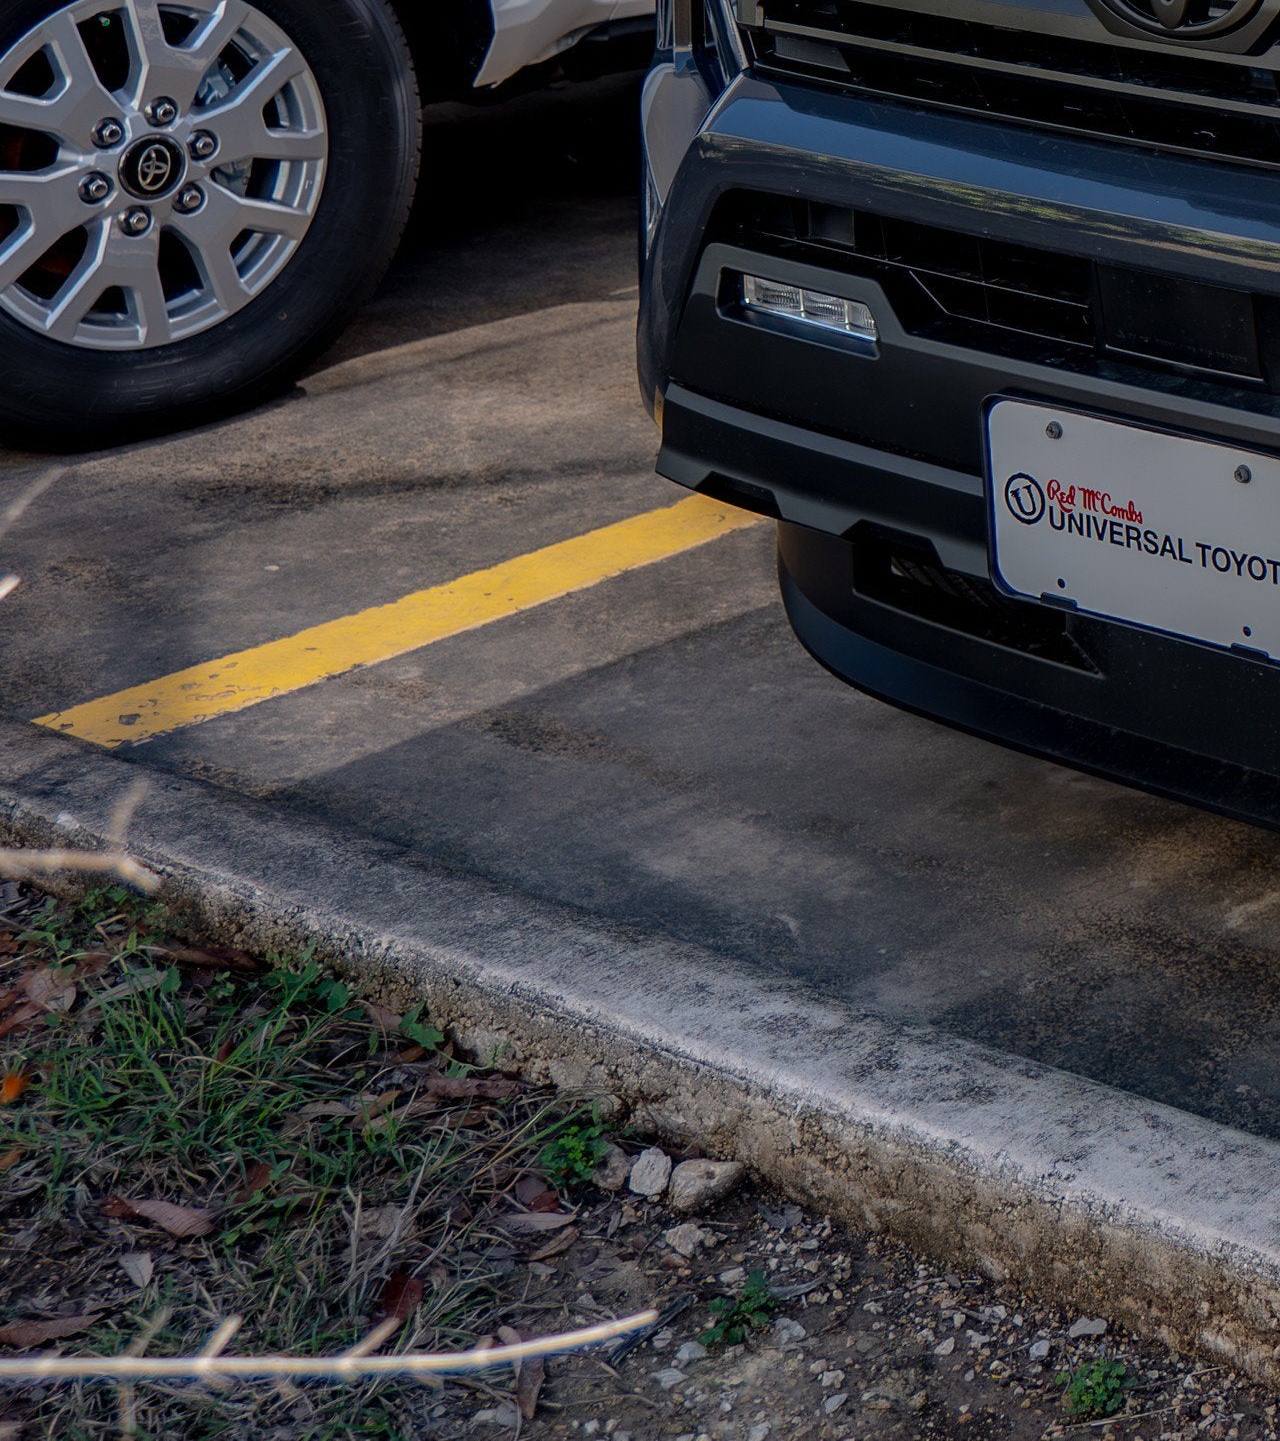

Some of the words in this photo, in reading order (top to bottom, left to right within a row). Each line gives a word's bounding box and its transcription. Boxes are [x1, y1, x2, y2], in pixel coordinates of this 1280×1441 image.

[1046, 479, 1076, 513] Red
[1078, 486, 1143, 524] McCombs
[1048, 505, 1193, 564] UNIVERSAL
